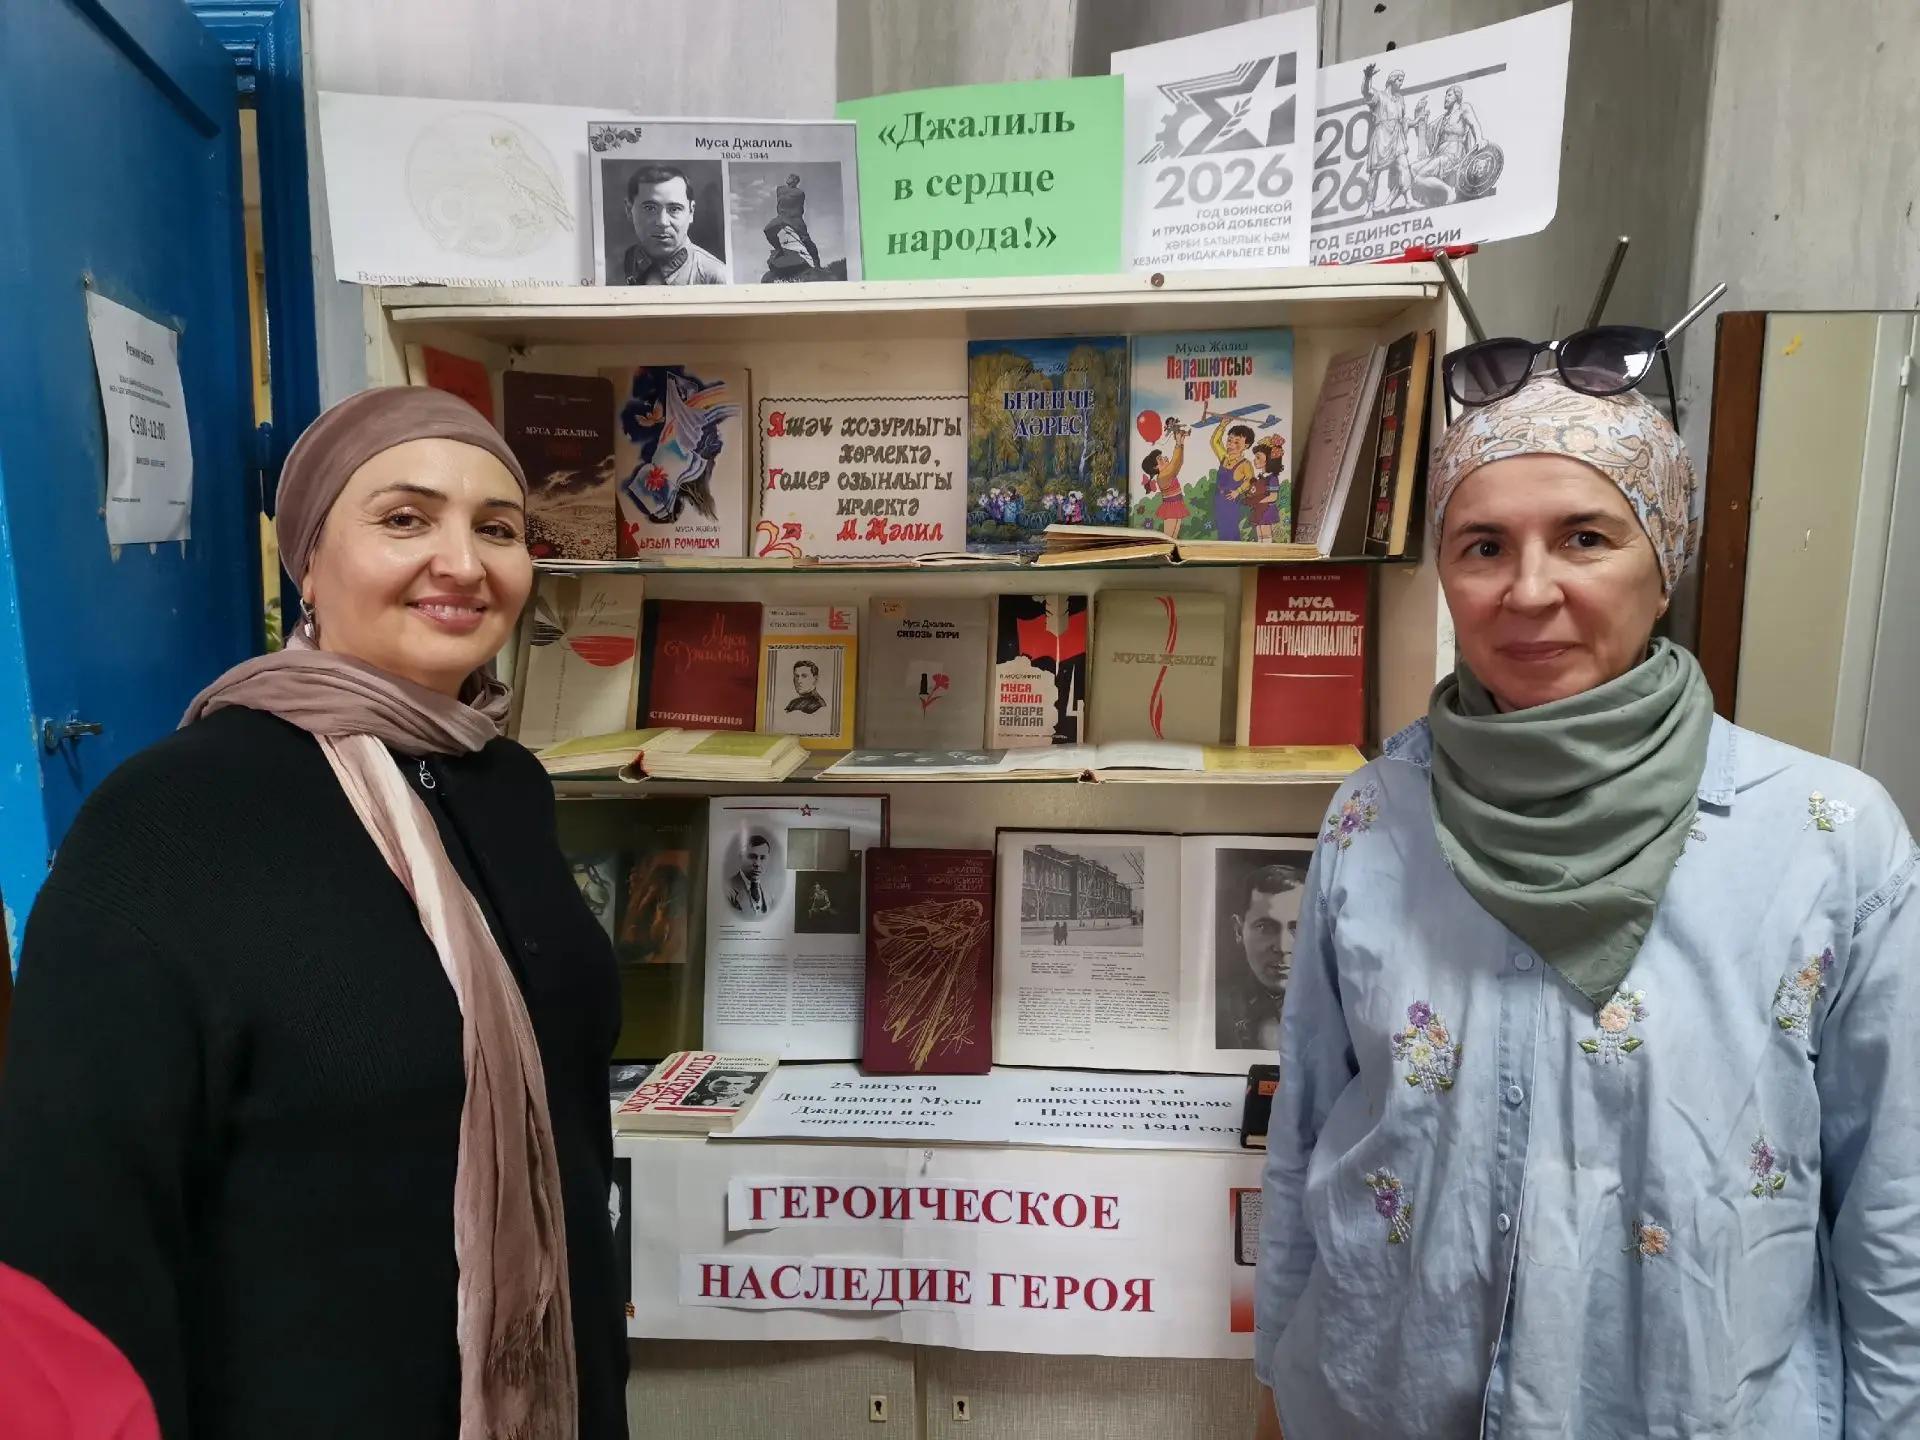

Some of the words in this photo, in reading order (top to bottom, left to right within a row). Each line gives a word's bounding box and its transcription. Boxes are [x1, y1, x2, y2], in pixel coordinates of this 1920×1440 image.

[878, 111, 1075, 152] «Джалиль
[1314, 110, 1375, 170] 20
[695, 137, 729, 149] Муса
[733, 137, 793, 149] Джалиль
[894, 177, 914, 201] в
[926, 168, 1055, 204] сердце
[1153, 153, 1294, 209] 2026
[1311, 160, 1369, 219] 26
[1196, 208, 1220, 220] ГОД
[1223, 200, 1293, 217] ВОИНСКОЙ
[1152, 228, 1161, 238] И
[1164, 219, 1225, 236] ТРУДОВОЙ
[1227, 215, 1292, 231] ДОБЛЕСТИ
[1310, 237, 1340, 251] ГОД
[1345, 216, 1433, 245] ЕДИНСТВА
[887, 217, 1057, 260] народа!»
[1203, 234, 1261, 247] БАТЫРЛЫК
[1310, 245, 1384, 266] НАРОДОВ
[1390, 228, 1461, 254] РОССИИ
[1177, 247, 1263, 262] ФИДАКАРЬЛЕГЕ
[1267, 245, 1290, 255] ЕЛЫ
[1166, 354, 1253, 381] Парашютсыз
[1002, 389, 1095, 411] БЕРЕНЧЕ
[1184, 379, 1238, 402] курчак
[525, 426, 550, 435] МУСА
[554, 427, 599, 438] ДЖАЛИЛЬ
[1013, 415, 1083, 440] ДӘРЕС
[674, 537, 720, 549] РОМАШКА
[1288, 596, 1335, 608] МУСА
[896, 630, 932, 639] СКВОЗЬ
[935, 630, 960, 639] БУРИ
[1255, 625, 1364, 658] ИНТЕРНАЦИОНАЛИСТ
[1113, 652, 1156, 665] МУСА
[1000, 683, 1032, 693] МУСА
[649, 711, 743, 725] СТИХОТВОРЕНИЯ
[999, 716, 1043, 727] БУЙЛАП
[651, 1054, 717, 1106] ДЖАЛИЛЬ
[859, 1083, 937, 1091] августа
[1050, 1086, 1165, 1094] казненных
[617, 1082, 667, 1113] МУСА
[777, 1093, 827, 1102] День
[920, 1097, 982, 1106] Мусы
[1148, 1099, 1232, 1108] тюрьме
[790, 1106, 892, 1115] Джалиля
[1144, 1123, 1190, 1131] 1944
[748, 1185, 1120, 1230] ГЕРОИЧЕСКОЕ
[698, 1263, 972, 1312] НАСЛЕДИЕ
[987, 1272, 1155, 1313] ГЕРОЯ
